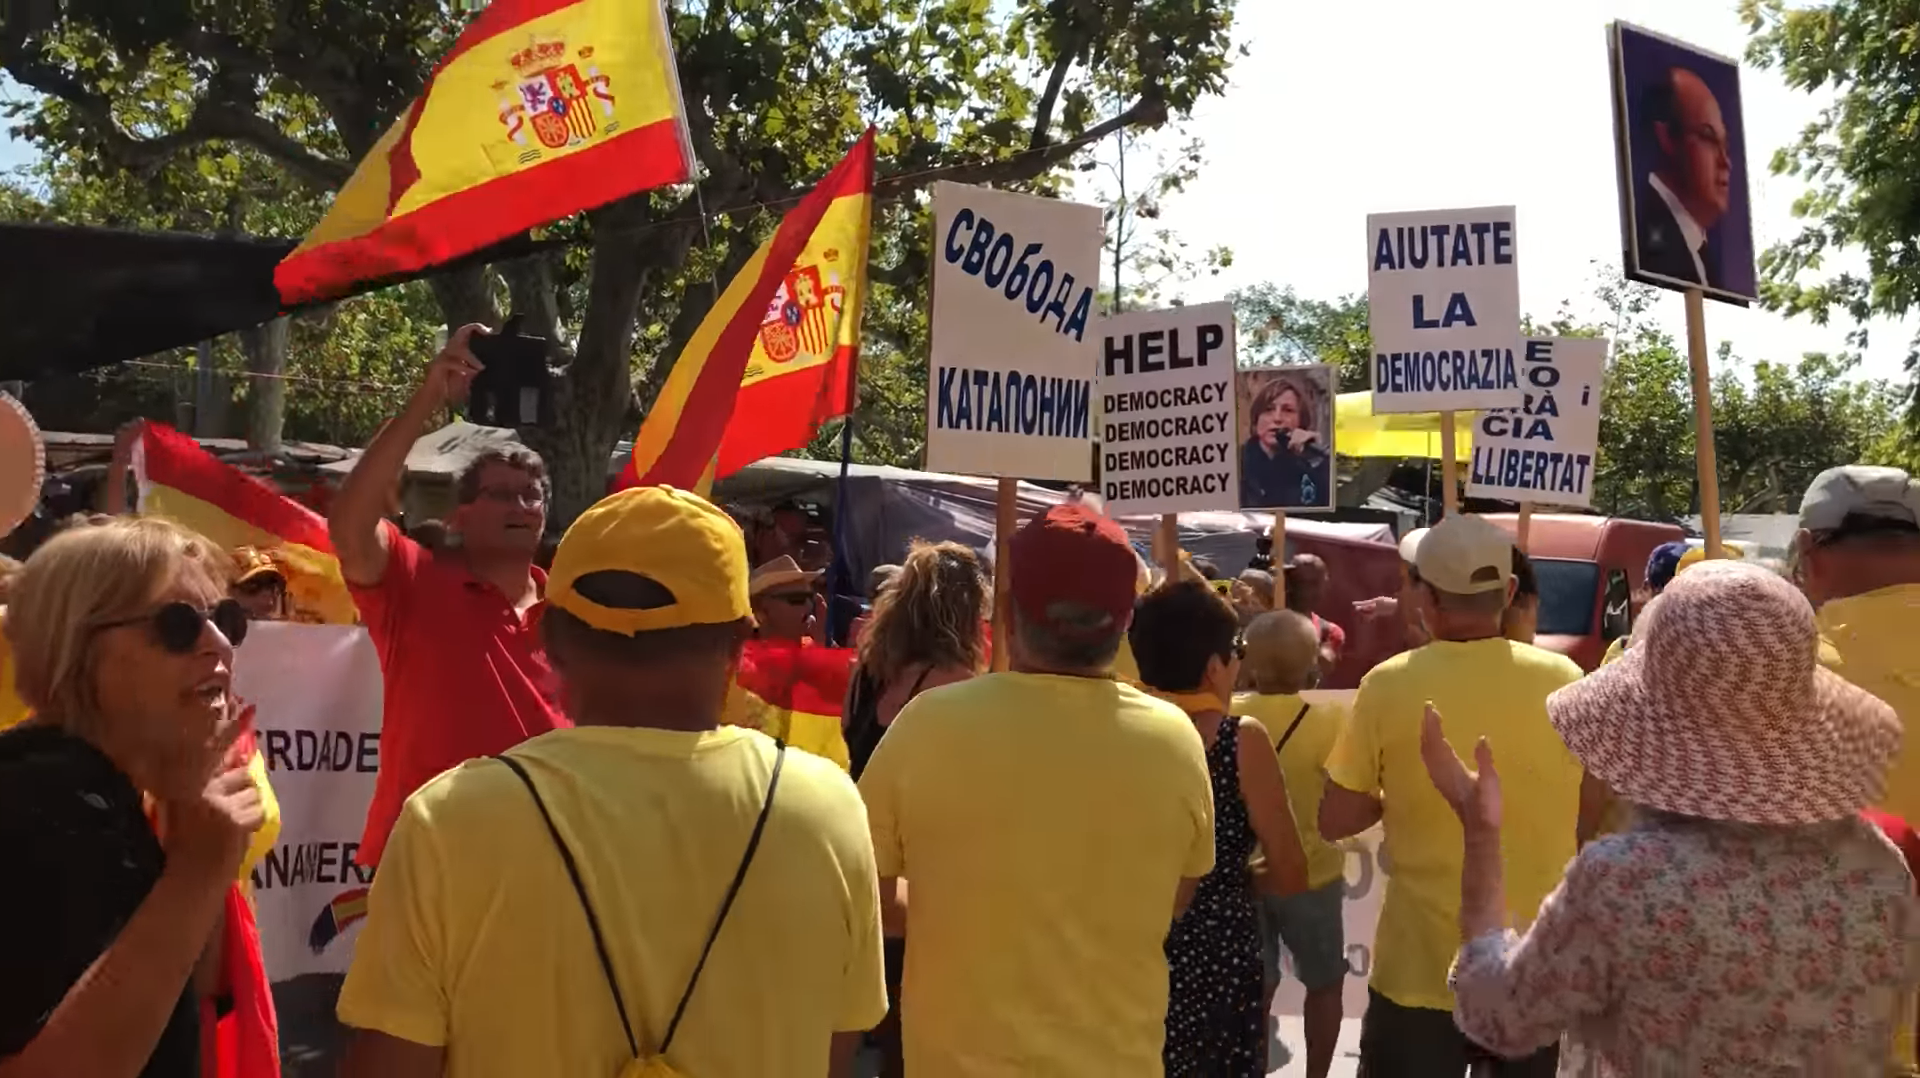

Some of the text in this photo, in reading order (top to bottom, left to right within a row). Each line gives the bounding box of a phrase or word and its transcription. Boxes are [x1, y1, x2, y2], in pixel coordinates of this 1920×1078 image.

[1373, 221, 1513, 272] AIUTATE
[1412, 292, 1478, 329] LA
[1104, 323, 1224, 377] HELP
[1525, 340, 1554, 363] E
[1376, 348, 1519, 394] DEMOCRAZIA
[1521, 365, 1561, 388] O
[1103, 380, 1228, 414] DEMOCRACY
[1104, 411, 1229, 443] DEMOCRACY
[1481, 415, 1554, 441] CIA
[1105, 442, 1229, 472] DEMOCRACY
[1471, 446, 1591, 494] LLIBERTAT
[1106, 472, 1230, 501] DEMOCRACY
[255, 729, 381, 773] RDADE
